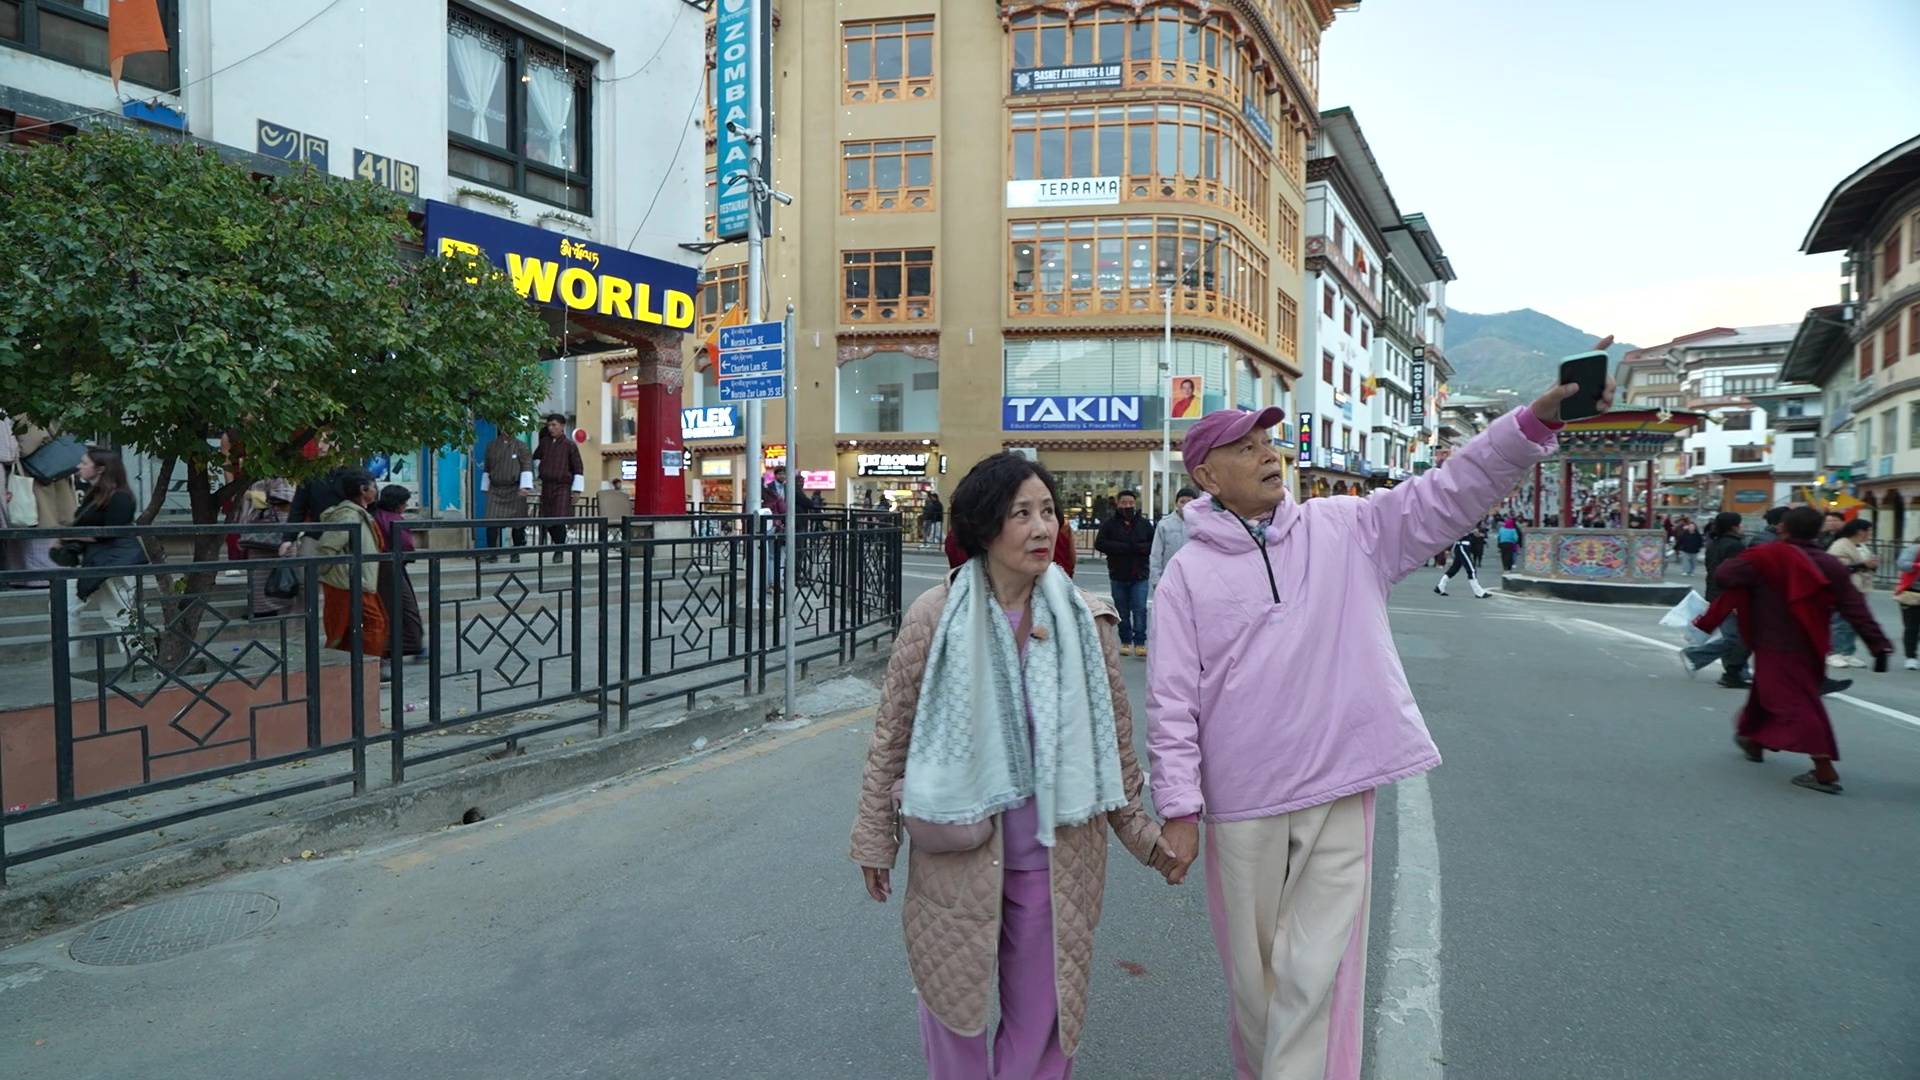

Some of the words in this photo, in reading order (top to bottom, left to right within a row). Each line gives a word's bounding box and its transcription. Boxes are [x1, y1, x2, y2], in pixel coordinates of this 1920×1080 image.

[1106, 65, 1121, 76] LAW
[723, 21, 746, 164] ZOMBALA
[358, 154, 388, 187] 41
[396, 162, 418, 195] (B)
[1040, 181, 1117, 195] TERRAMA
[505, 252, 695, 329] WORLD
[1008, 397, 1138, 421] TAKIN
[1301, 415, 1310, 459] TAKIN
